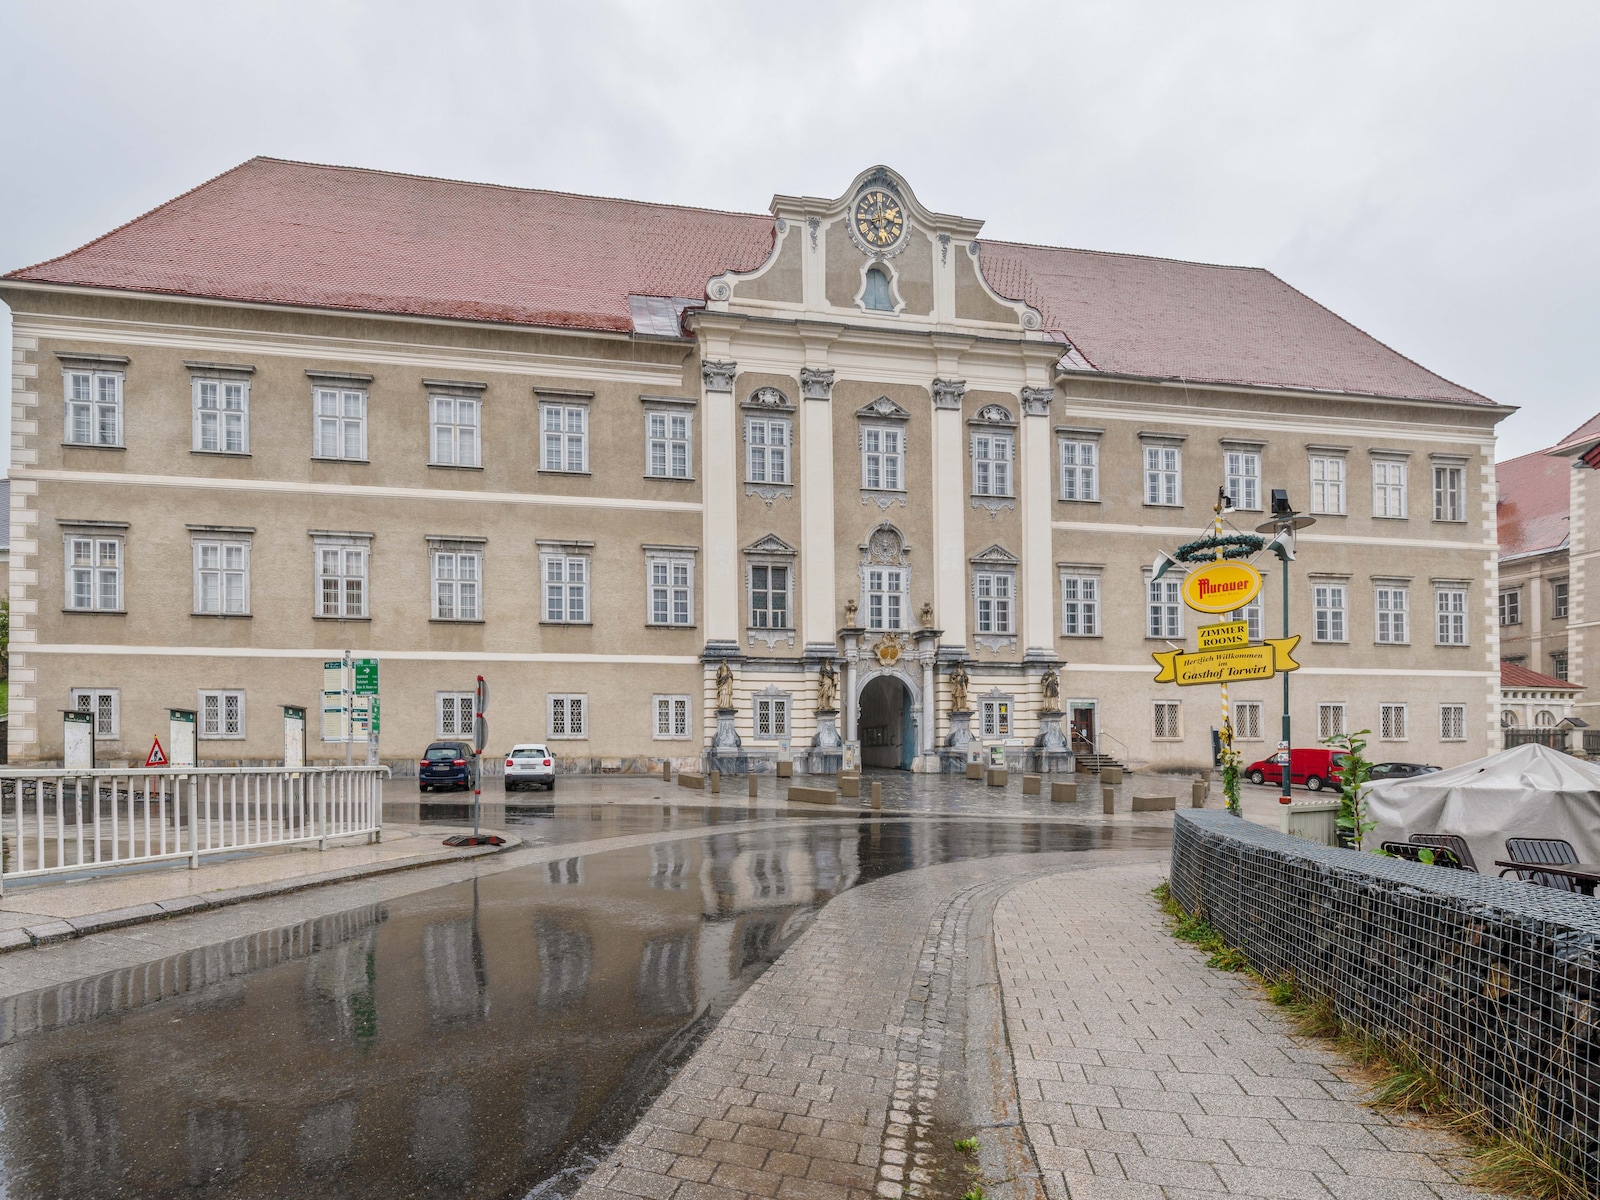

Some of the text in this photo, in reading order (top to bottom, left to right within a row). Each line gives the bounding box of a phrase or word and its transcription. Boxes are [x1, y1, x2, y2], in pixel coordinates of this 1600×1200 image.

[1198, 578, 1249, 599] Murauer
[1201, 626, 1245, 638] ZIMMER
[1203, 636, 1243, 647] ROOMS
[1184, 652, 1263, 667] Herzlich Willkommen
[1182, 665, 1267, 681] Gasthof Torwirt
